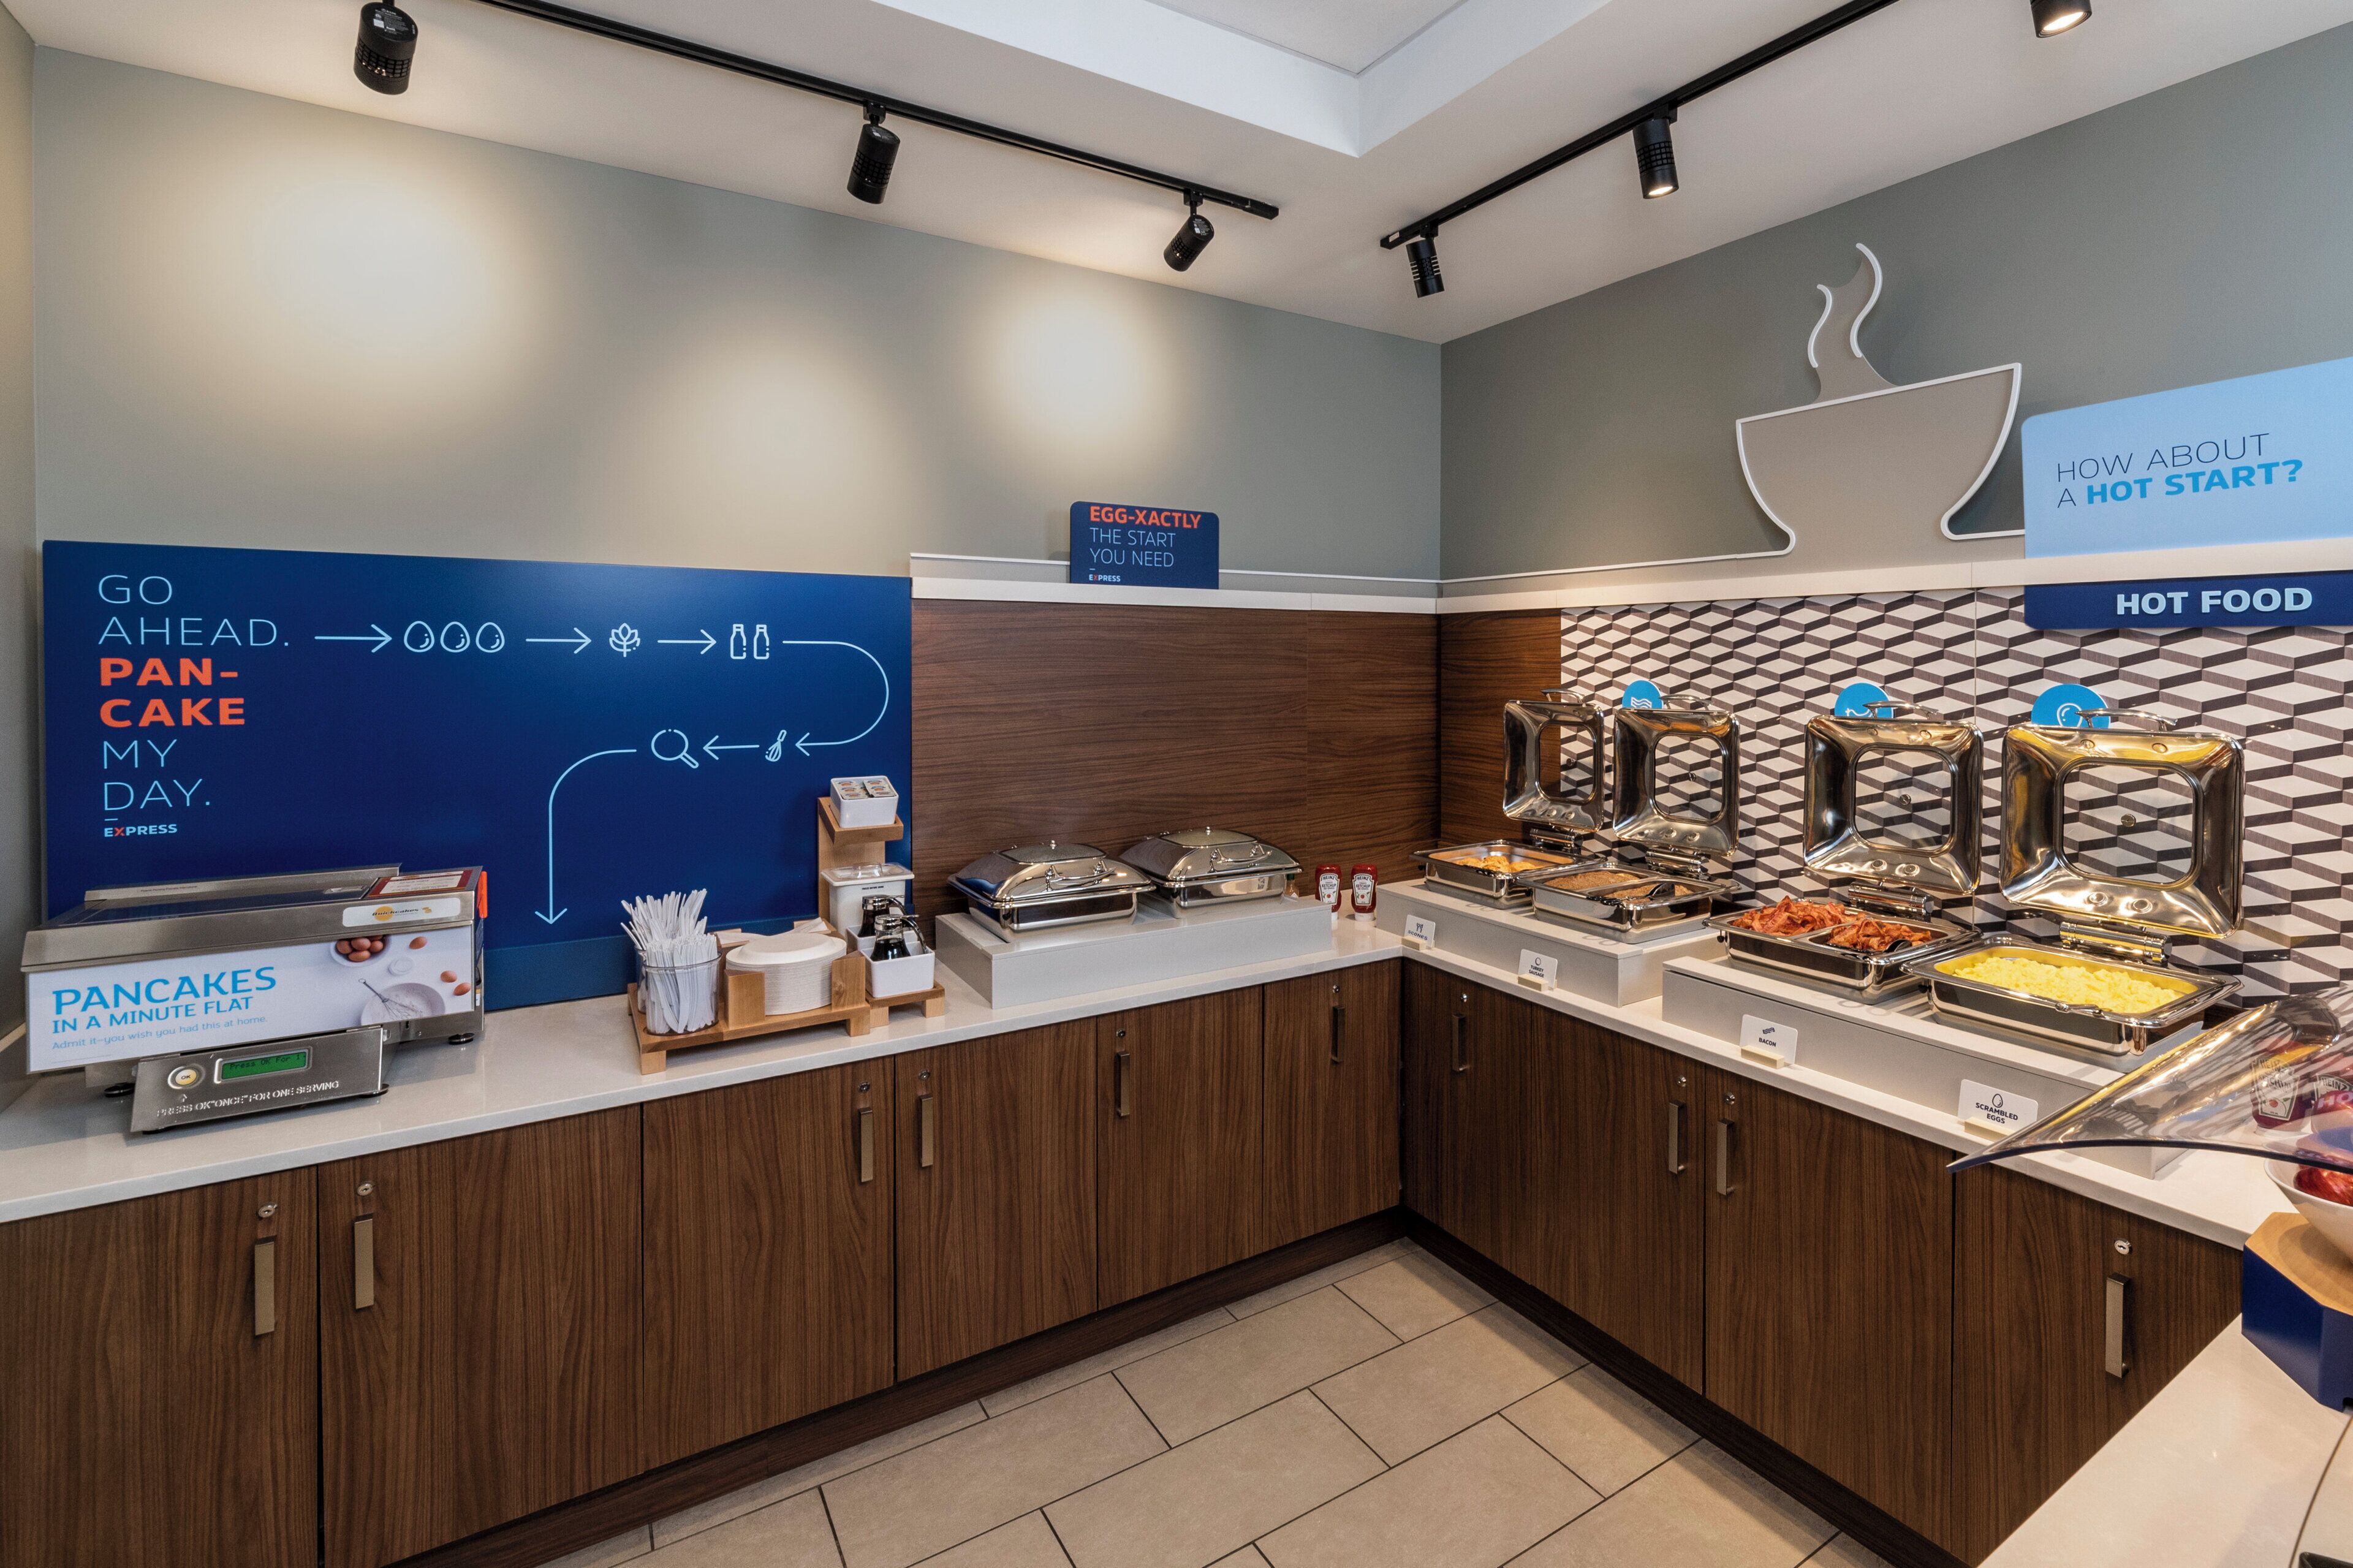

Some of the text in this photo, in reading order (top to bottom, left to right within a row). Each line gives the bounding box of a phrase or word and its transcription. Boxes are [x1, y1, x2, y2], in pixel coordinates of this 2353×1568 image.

[2057, 432, 2270, 483] HOW ABOUT
[2057, 459, 2303, 509] A HOT START?
[1089, 506, 1202, 529] EGG-XACTLY
[1089, 527, 1176, 547] THE START
[1089, 548, 1174, 567] YOU NEED
[98, 574, 173, 605] GO
[2116, 588, 2313, 615] HOT FOOD
[98, 616, 289, 646] AHEAD.
[100, 657, 238, 686] PAN-
[100, 698, 245, 728] CAKE
[104, 739, 177, 769] MY
[104, 778, 210, 811] DAY.
[104, 824, 178, 838] EXPRESS
[1408, 930, 1428, 941] SCONES
[1528, 969, 1545, 978] SAUSAGE
[1531, 964, 1544, 973] TURKEY
[52, 966, 276, 1015] PANCAKES
[52, 996, 253, 1034] IN A MINUTE FLAT
[52, 1039, 86, 1050] Admit
[128, 1029, 152, 1040] wish
[156, 1028, 176, 1038] you
[180, 1023, 199, 1033] had
[202, 1020, 221, 1031] this
[224, 1019, 233, 1028] at
[237, 1015, 268, 1026] home.
[1759, 1037, 1776, 1047] BACON
[230, 1061, 256, 1070] Press
[157, 1104, 193, 1117] PRESS
[195, 1101, 211, 1110] OK
[249, 1092, 271, 1101] FOR
[272, 1087, 294, 1098] ONE
[296, 1080, 339, 1094] SERVING
[1976, 1102, 2018, 1121] SCRAMBLED
[1987, 1113, 2006, 1124] EGGS
